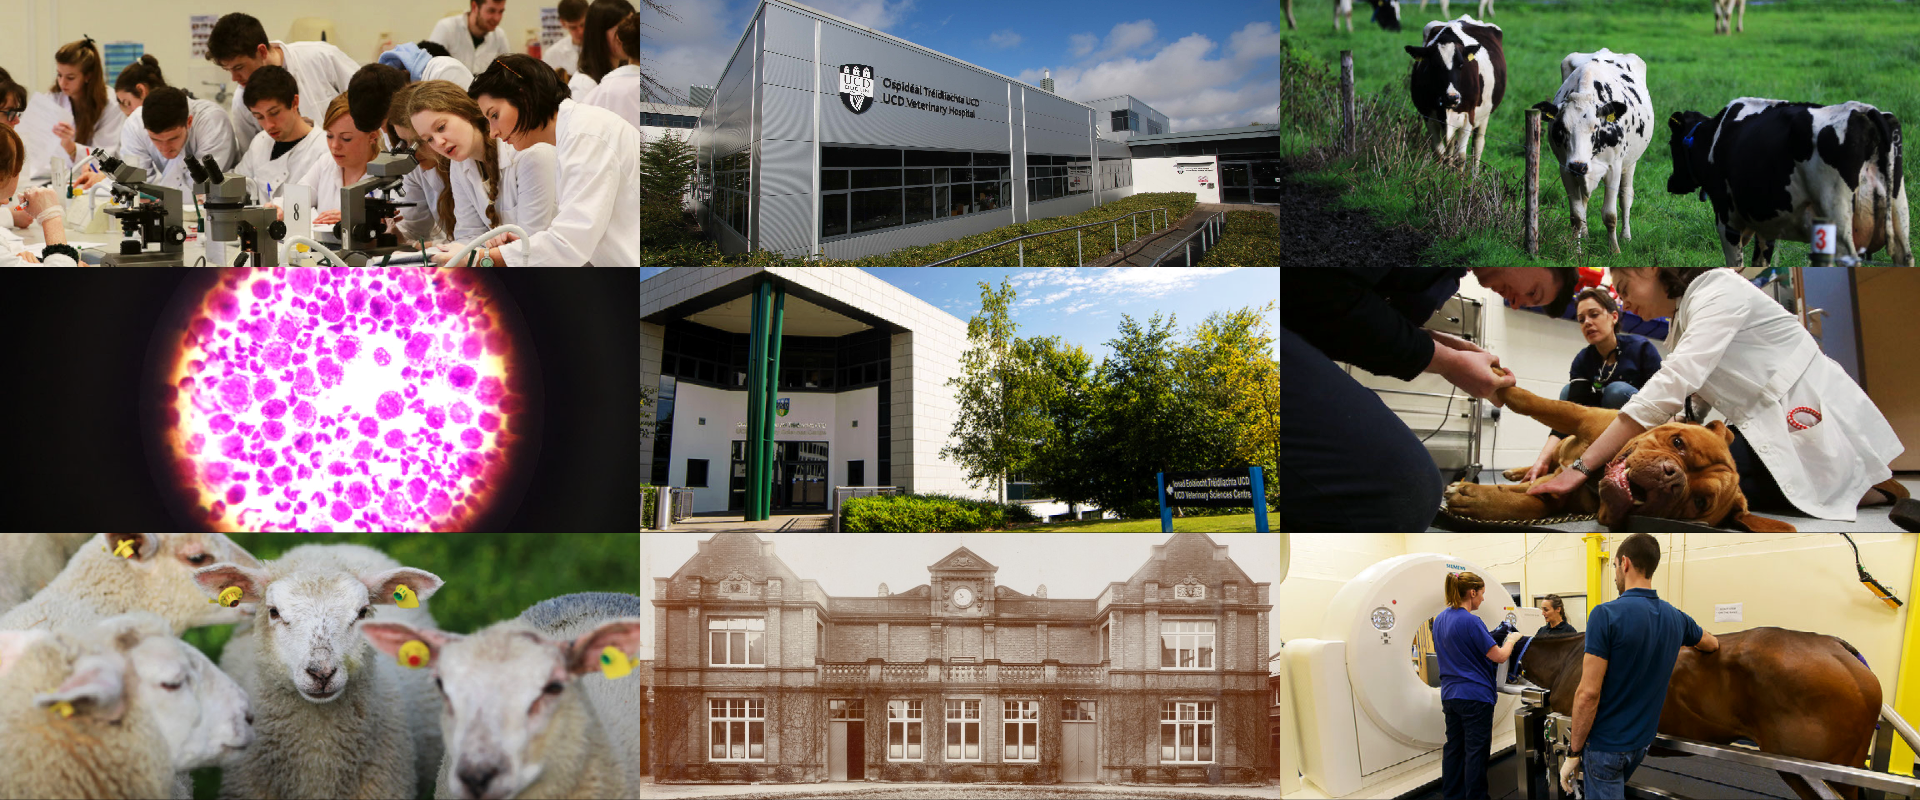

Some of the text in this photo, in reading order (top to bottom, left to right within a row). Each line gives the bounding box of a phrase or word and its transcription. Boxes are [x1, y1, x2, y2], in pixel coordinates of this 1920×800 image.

[844, 75, 871, 89] UCD
[882, 77, 923, 95] Ospidéal
[965, 97, 980, 107] UCD
[882, 93, 976, 119] UCD Veterinary Hospital
[293, 203, 300, 221] 8
[1816, 228, 1827, 250] 3
[1237, 476, 1250, 486] UCD
[1174, 488, 1253, 501] UCD Veterinary Sciences Centre
